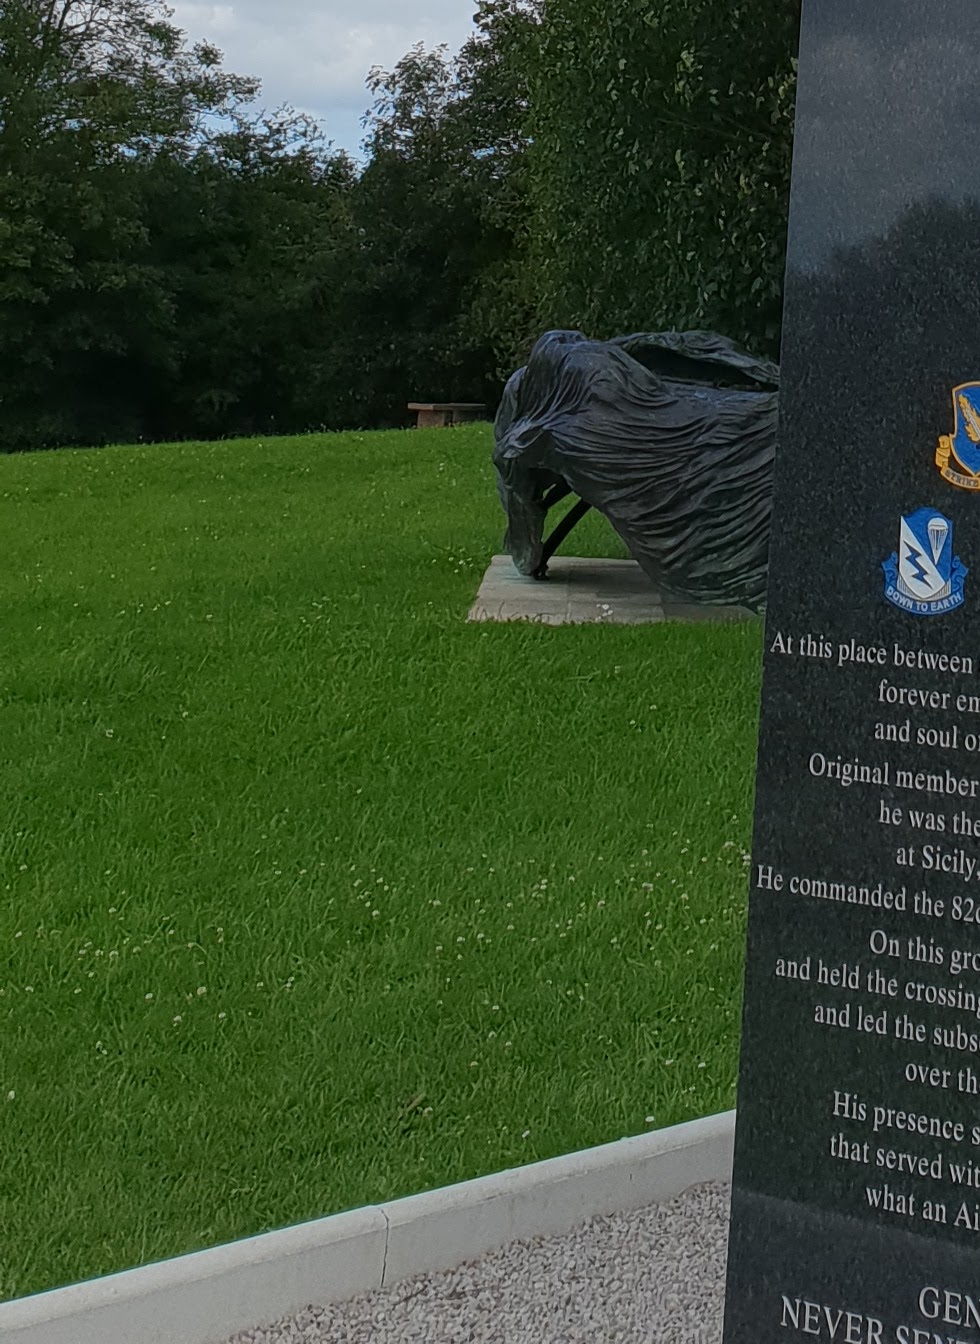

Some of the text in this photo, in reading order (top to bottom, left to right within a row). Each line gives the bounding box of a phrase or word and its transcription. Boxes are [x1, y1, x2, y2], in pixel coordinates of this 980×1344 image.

[945, 469, 979, 487] STRIKE
[887, 586, 961, 611] DOWN TO EARTH
[769, 631, 794, 655] At
[799, 633, 833, 659] this
[837, 638, 888, 667] place
[893, 642, 973, 675] between
[874, 718, 911, 743] and
[916, 724, 958, 749] soul
[808, 752, 890, 787] Original
[895, 769, 980, 798] member
[895, 845, 916, 867] at
[756, 864, 784, 892] He
[789, 876, 907, 911] commanded
[913, 889, 945, 918] the
[775, 955, 811, 981] and
[817, 958, 860, 990] held
[866, 968, 899, 997] the
[832, 1089, 867, 1122] His
[872, 1106, 965, 1142] presence
[781, 1295, 885, 1344] NEVER
